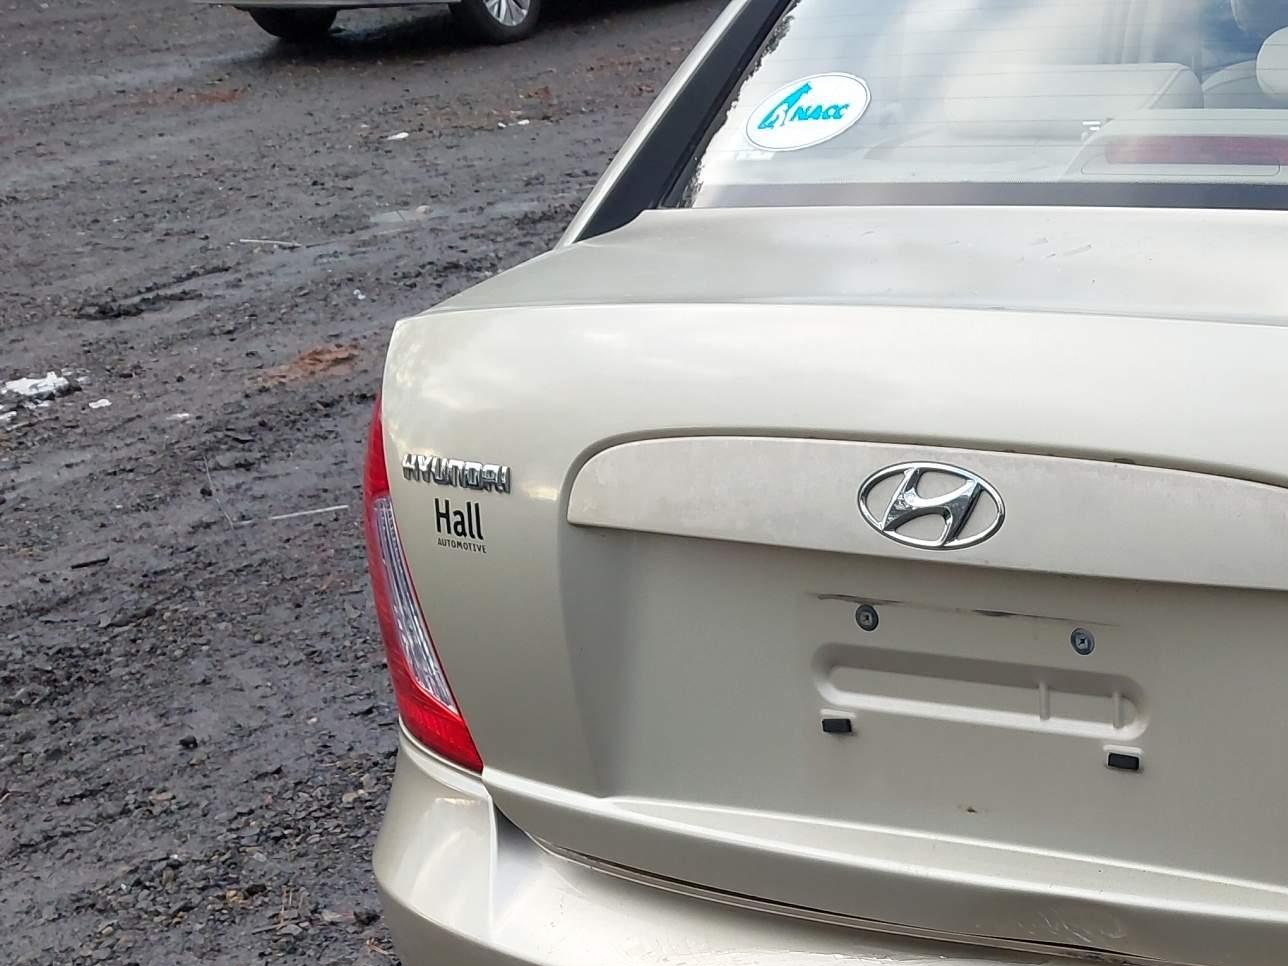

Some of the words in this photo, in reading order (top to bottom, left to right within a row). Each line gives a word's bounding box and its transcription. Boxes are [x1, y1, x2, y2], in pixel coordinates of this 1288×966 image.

[788, 103, 849, 121] NACC
[402, 453, 511, 494] HYUNDAI
[434, 498, 484, 540] Hall
[437, 538, 487, 553] AUTOMOTIVE
